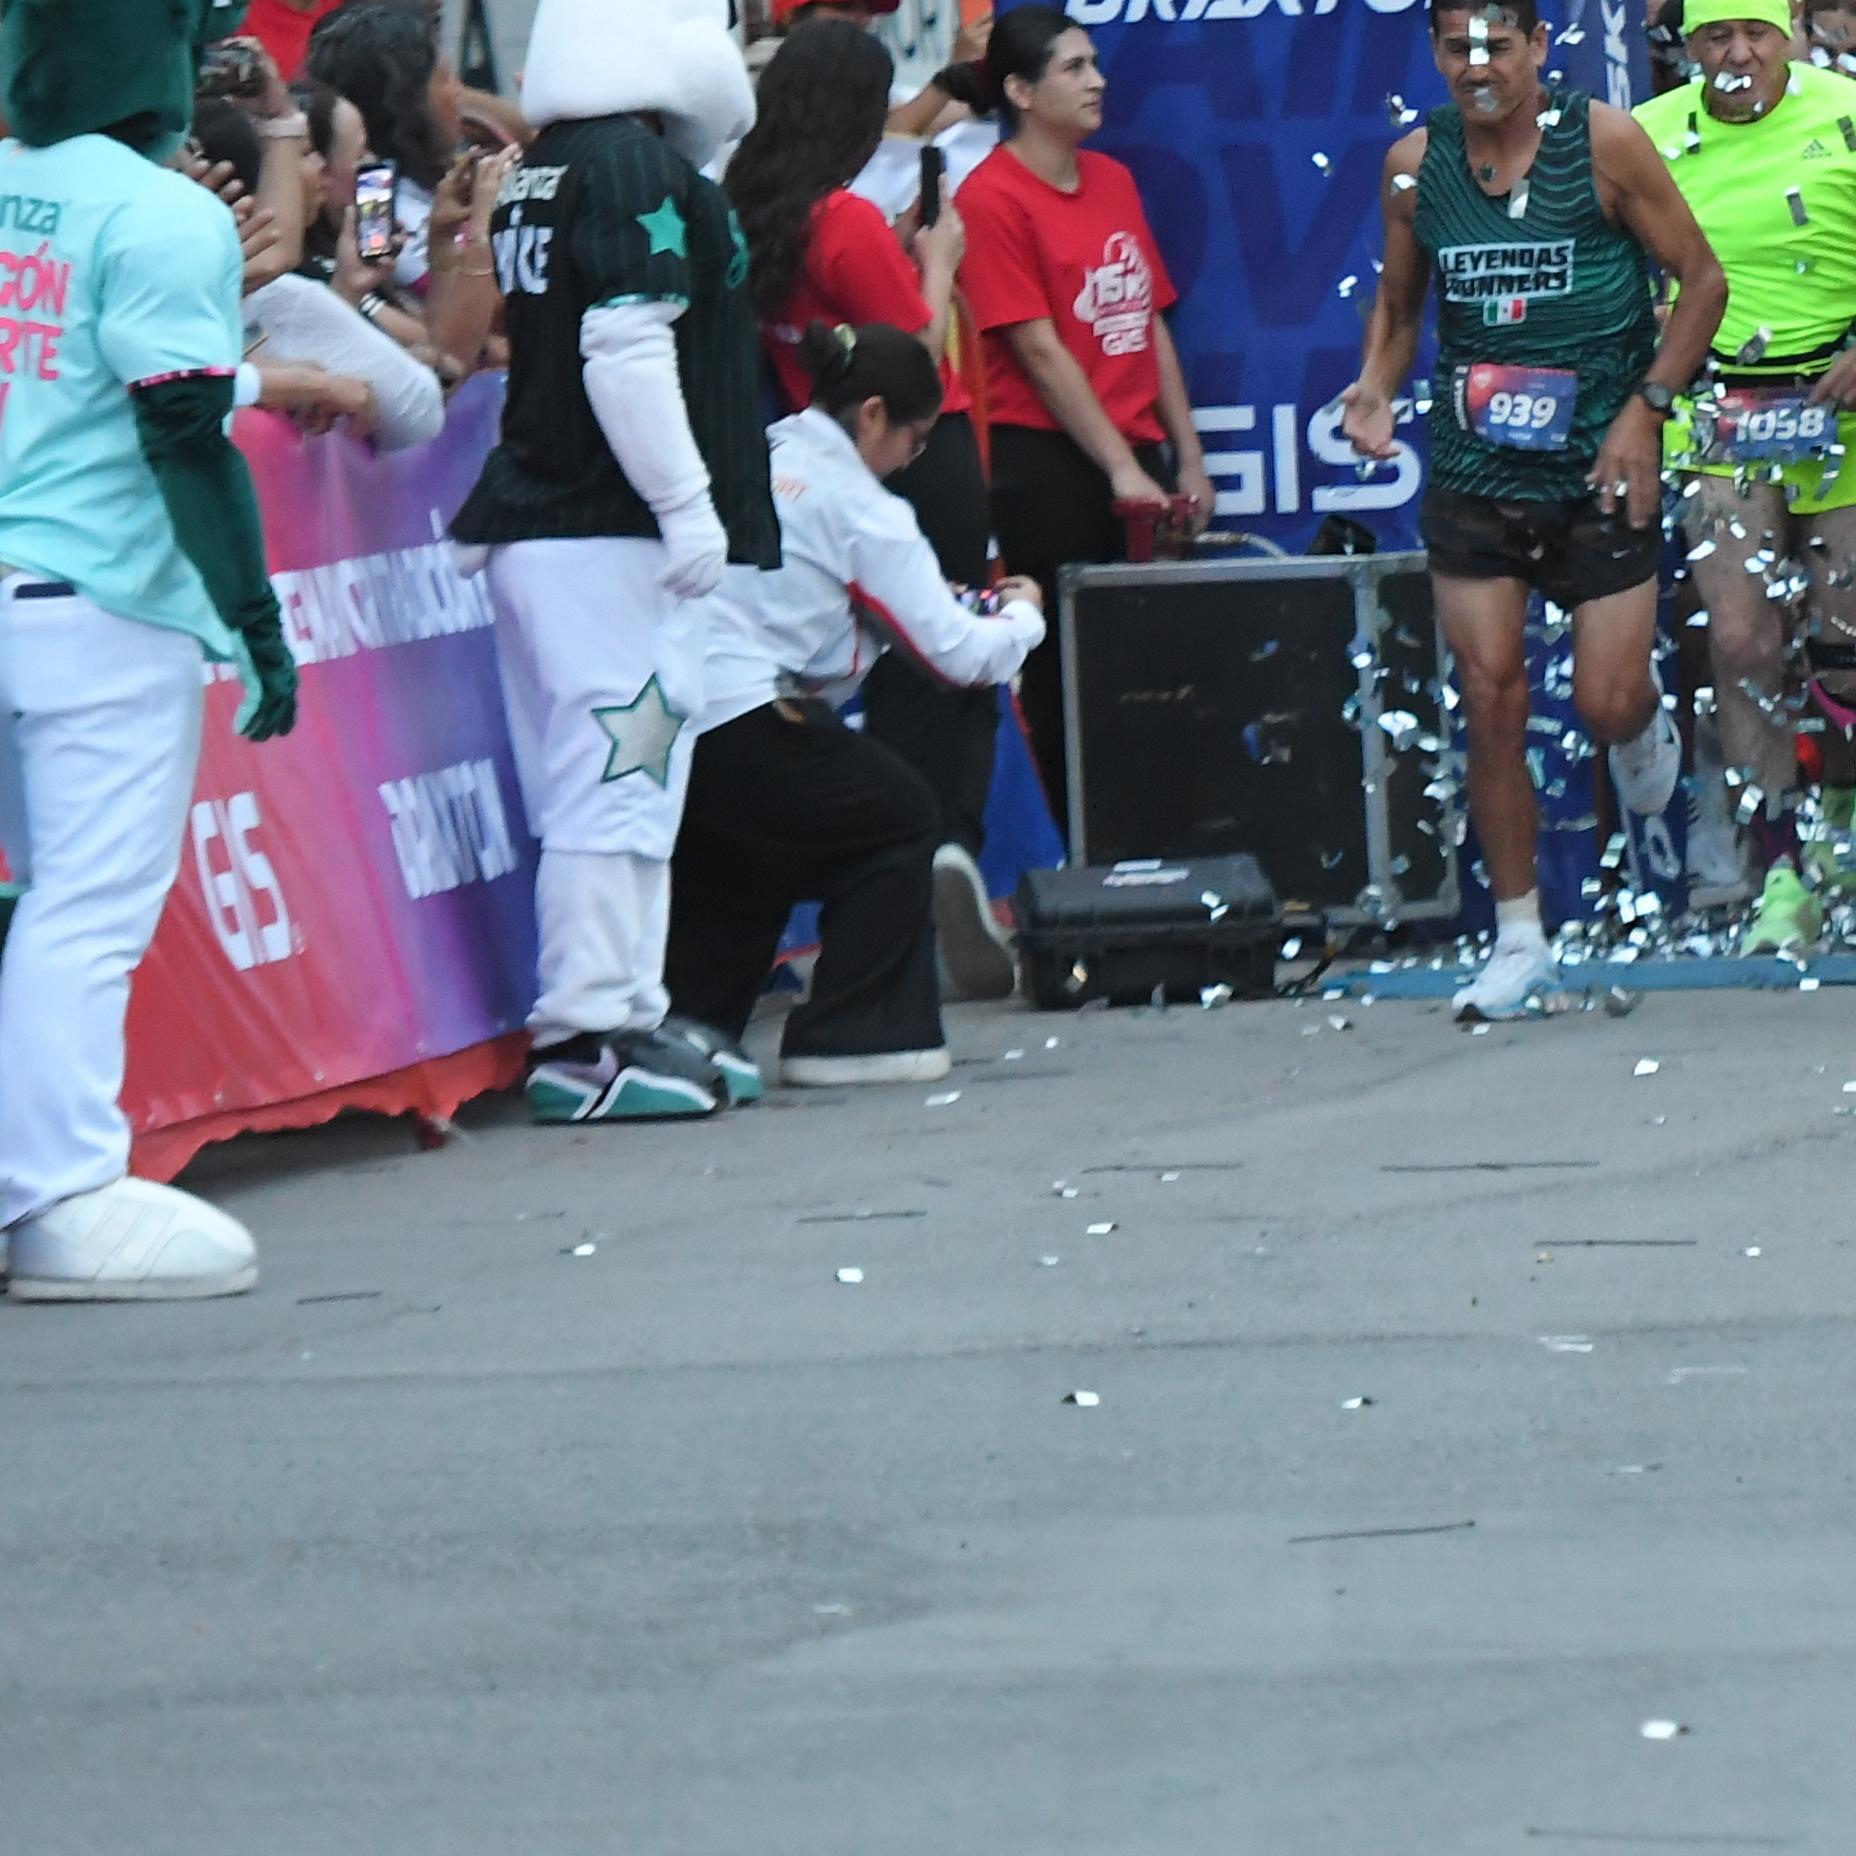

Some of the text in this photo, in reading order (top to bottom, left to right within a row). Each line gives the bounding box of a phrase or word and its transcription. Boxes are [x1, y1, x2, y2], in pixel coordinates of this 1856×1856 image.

[1442, 245, 1569, 273] LEYENDAS
[1488, 392, 1557, 430] 939
[1735, 407, 1826, 444] 1058
